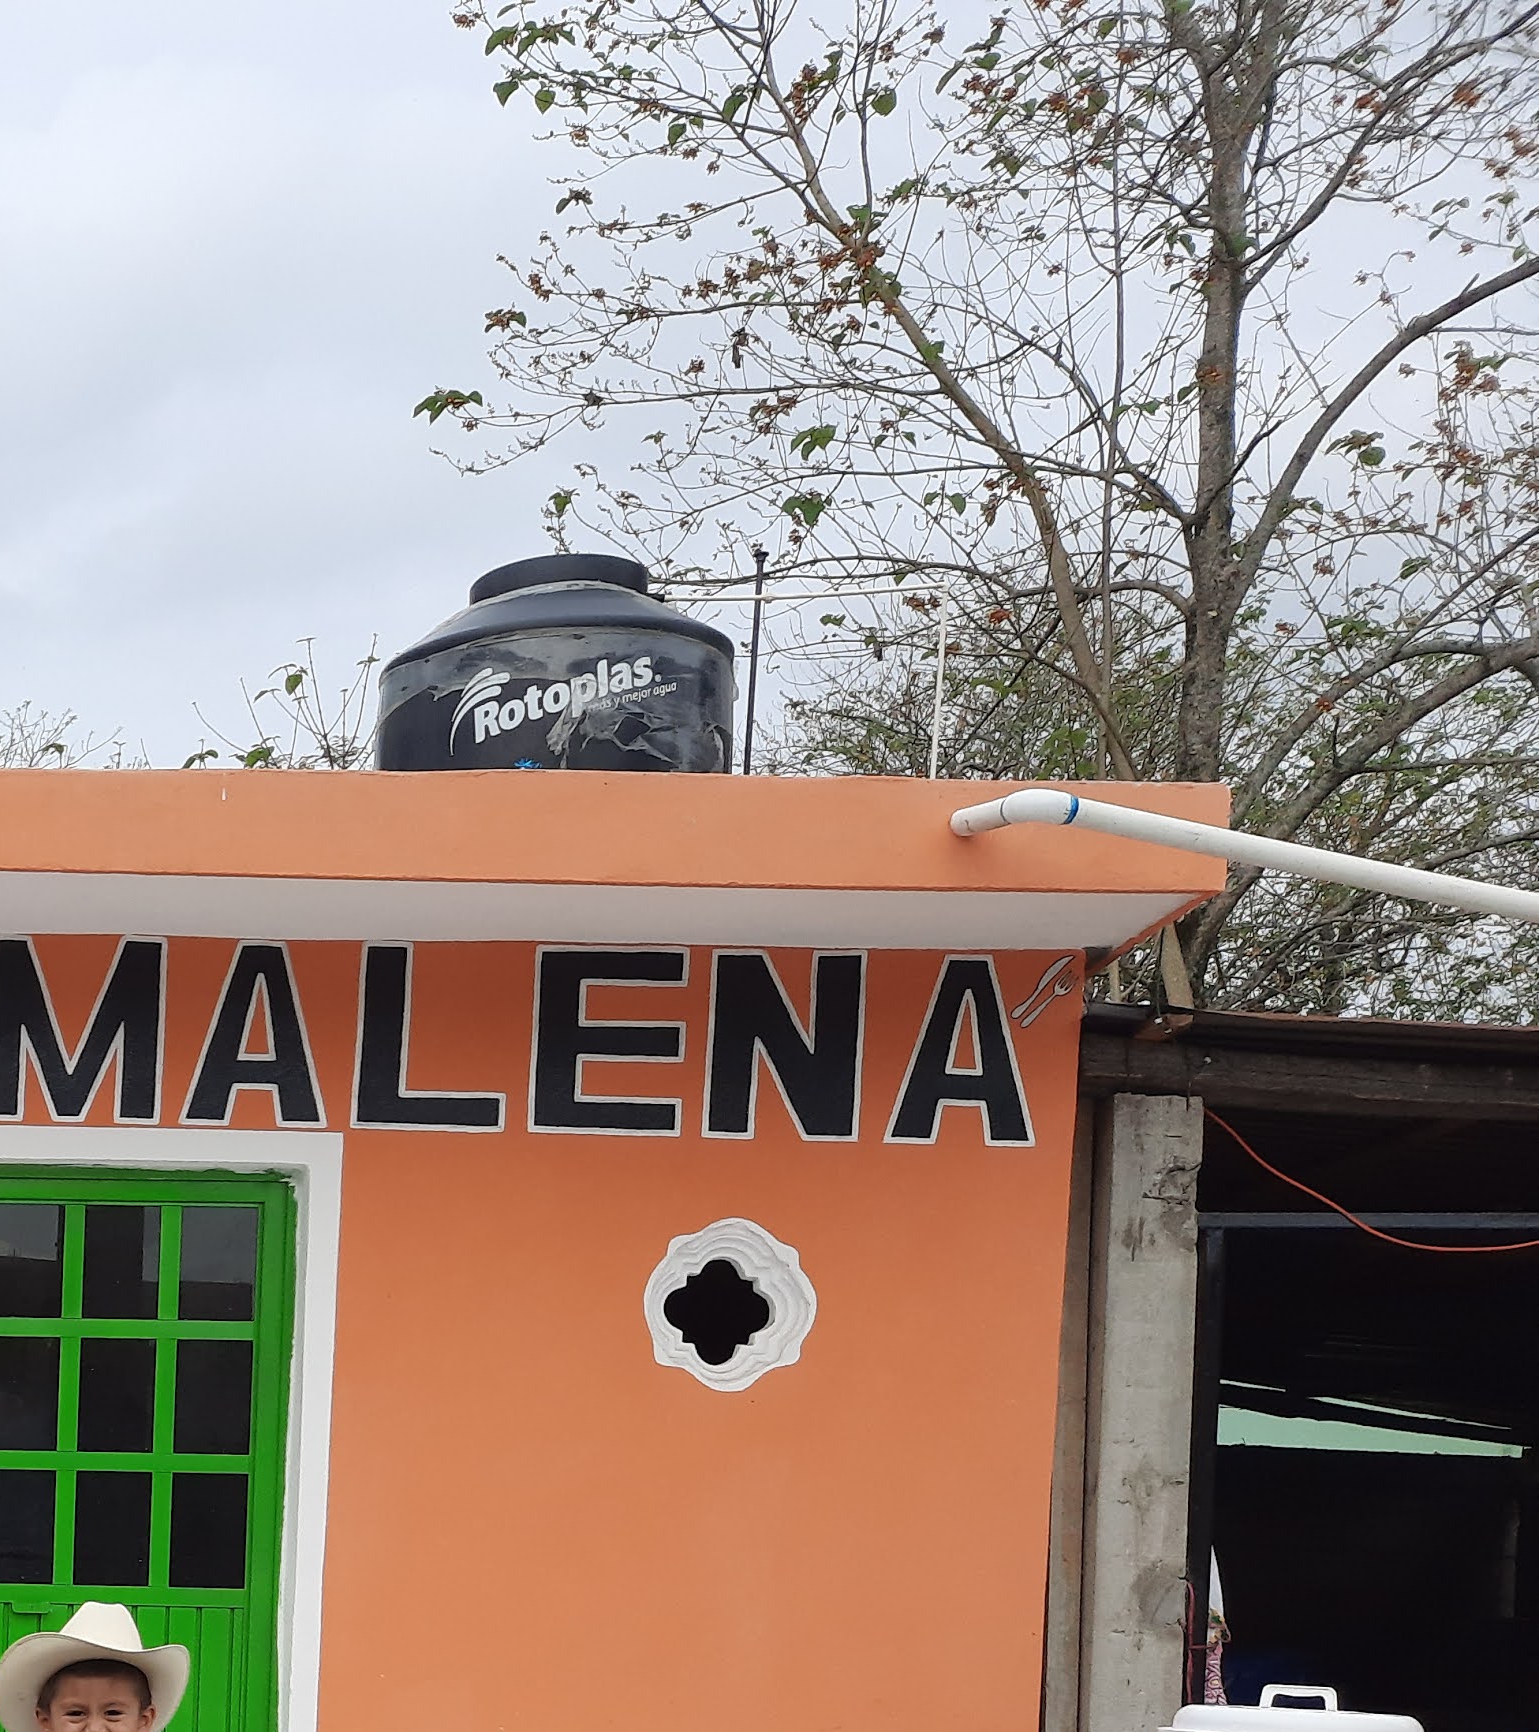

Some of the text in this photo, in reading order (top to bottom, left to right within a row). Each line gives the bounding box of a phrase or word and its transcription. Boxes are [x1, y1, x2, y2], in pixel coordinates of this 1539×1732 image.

[613, 696, 620, 710] y
[622, 687, 652, 703] mejor
[653, 681, 677, 697] agua
